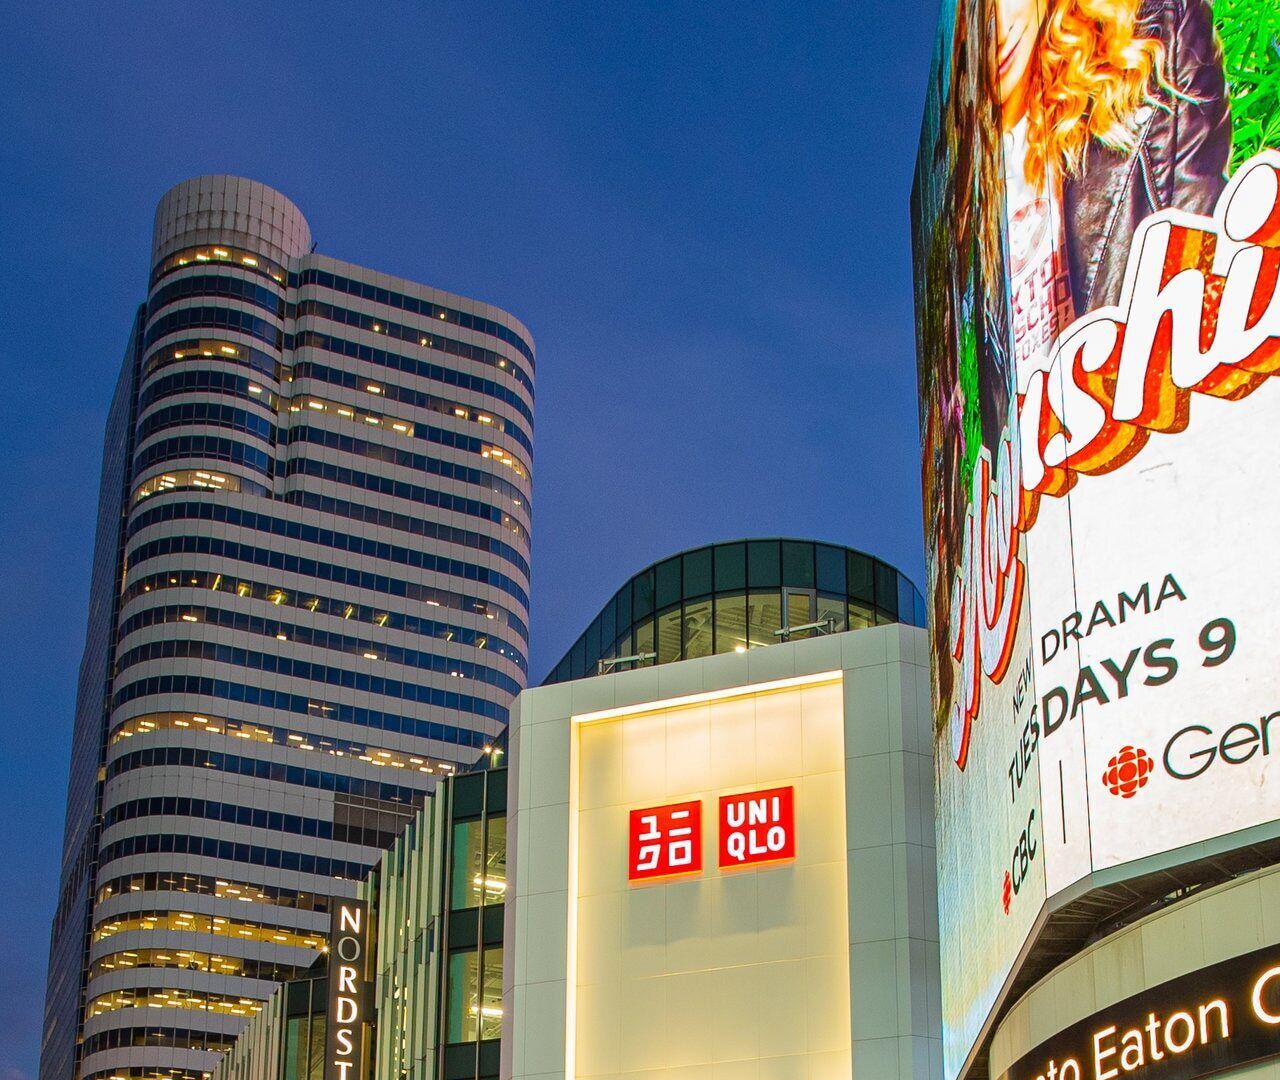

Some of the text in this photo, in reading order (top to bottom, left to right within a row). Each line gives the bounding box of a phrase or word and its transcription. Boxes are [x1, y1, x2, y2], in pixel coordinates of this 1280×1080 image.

[1009, 617, 1237, 804] TUESDAYS 9
[1012, 573, 1187, 725] NEW DRAMA
[1011, 808, 1037, 895] CBC
